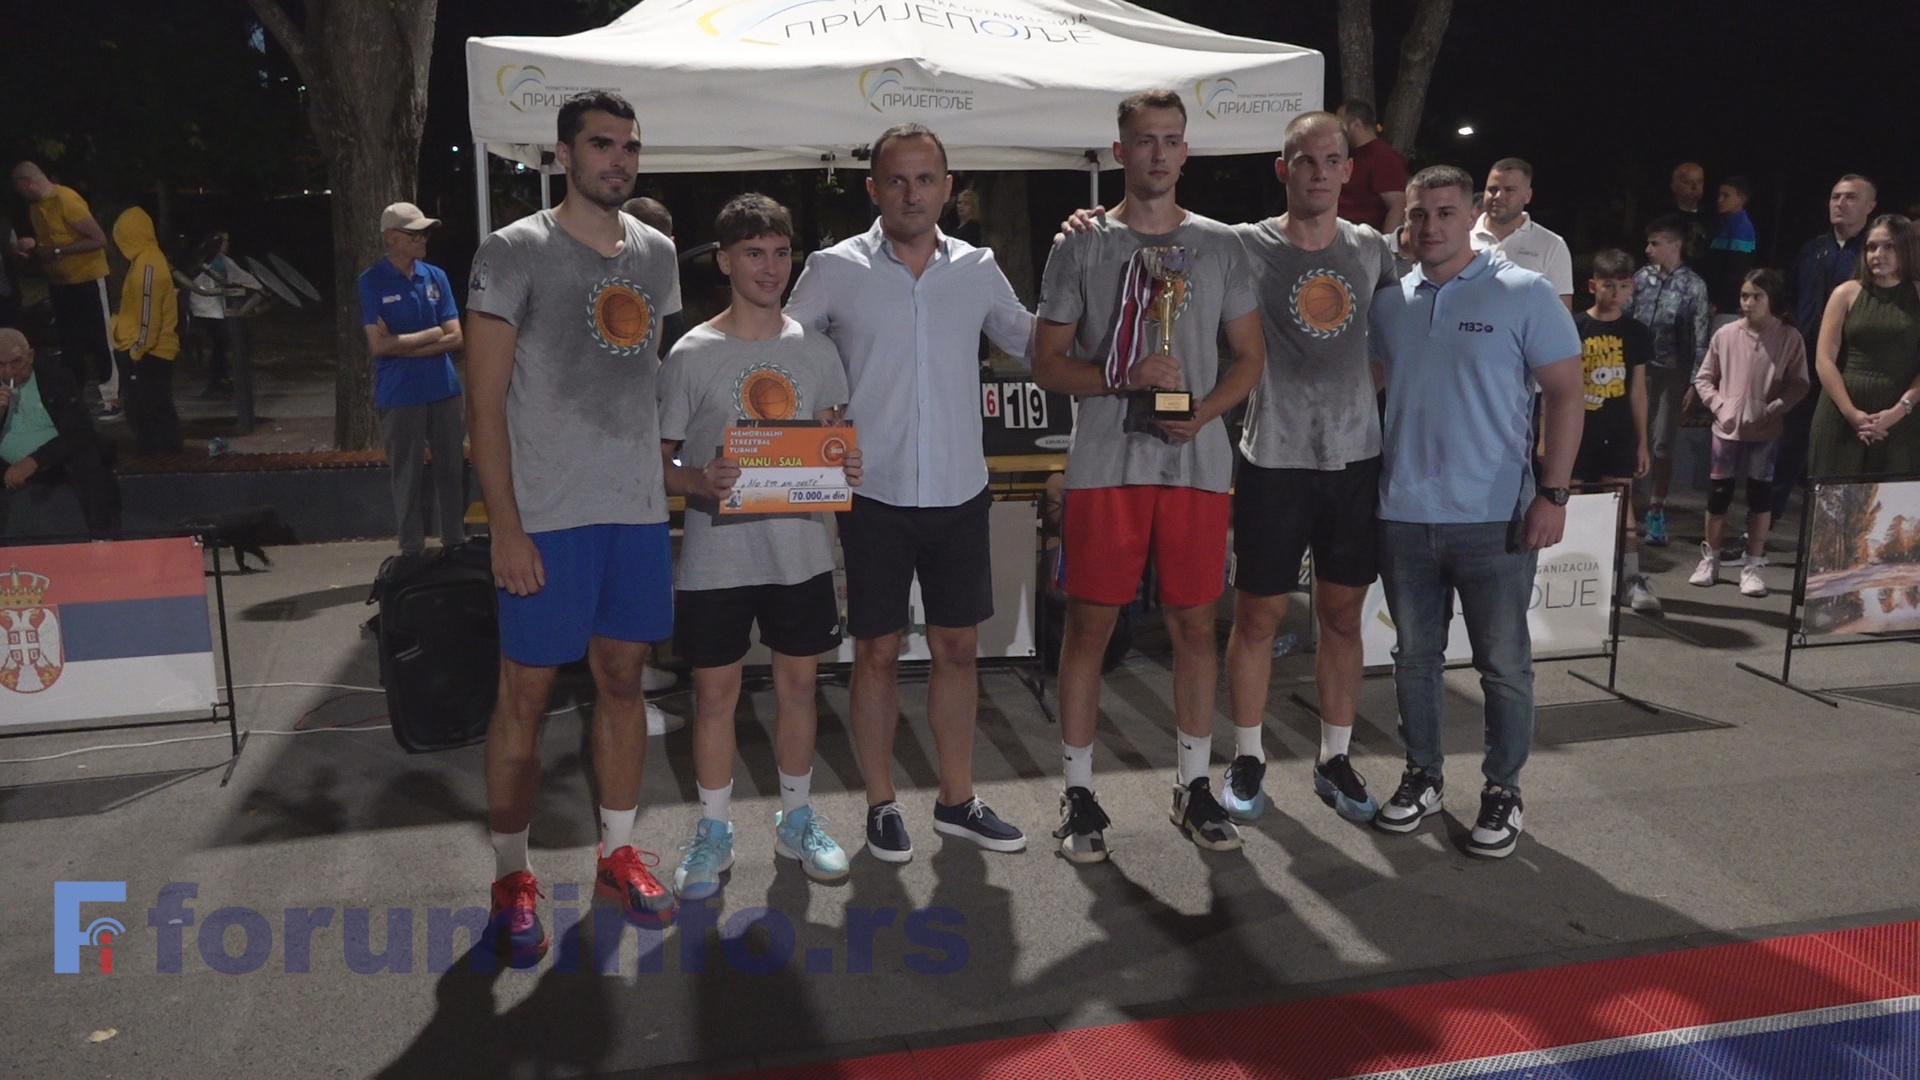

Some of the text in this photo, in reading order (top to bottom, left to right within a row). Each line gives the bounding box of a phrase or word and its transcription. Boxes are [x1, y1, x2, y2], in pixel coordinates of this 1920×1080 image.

[785, 2, 1101, 46] ПРИЈЕПОЉЕ
[882, 93, 974, 110] ПРИЈЕПОЉЕ
[1217, 99, 1302, 114] ПРИЈЕПОЉЕ
[986, 389, 996, 416] 6
[1006, 389, 1044, 427] 19
[739, 456, 772, 467] IVANU
[779, 456, 803, 467] SAJA
[832, 491, 846, 501] din
